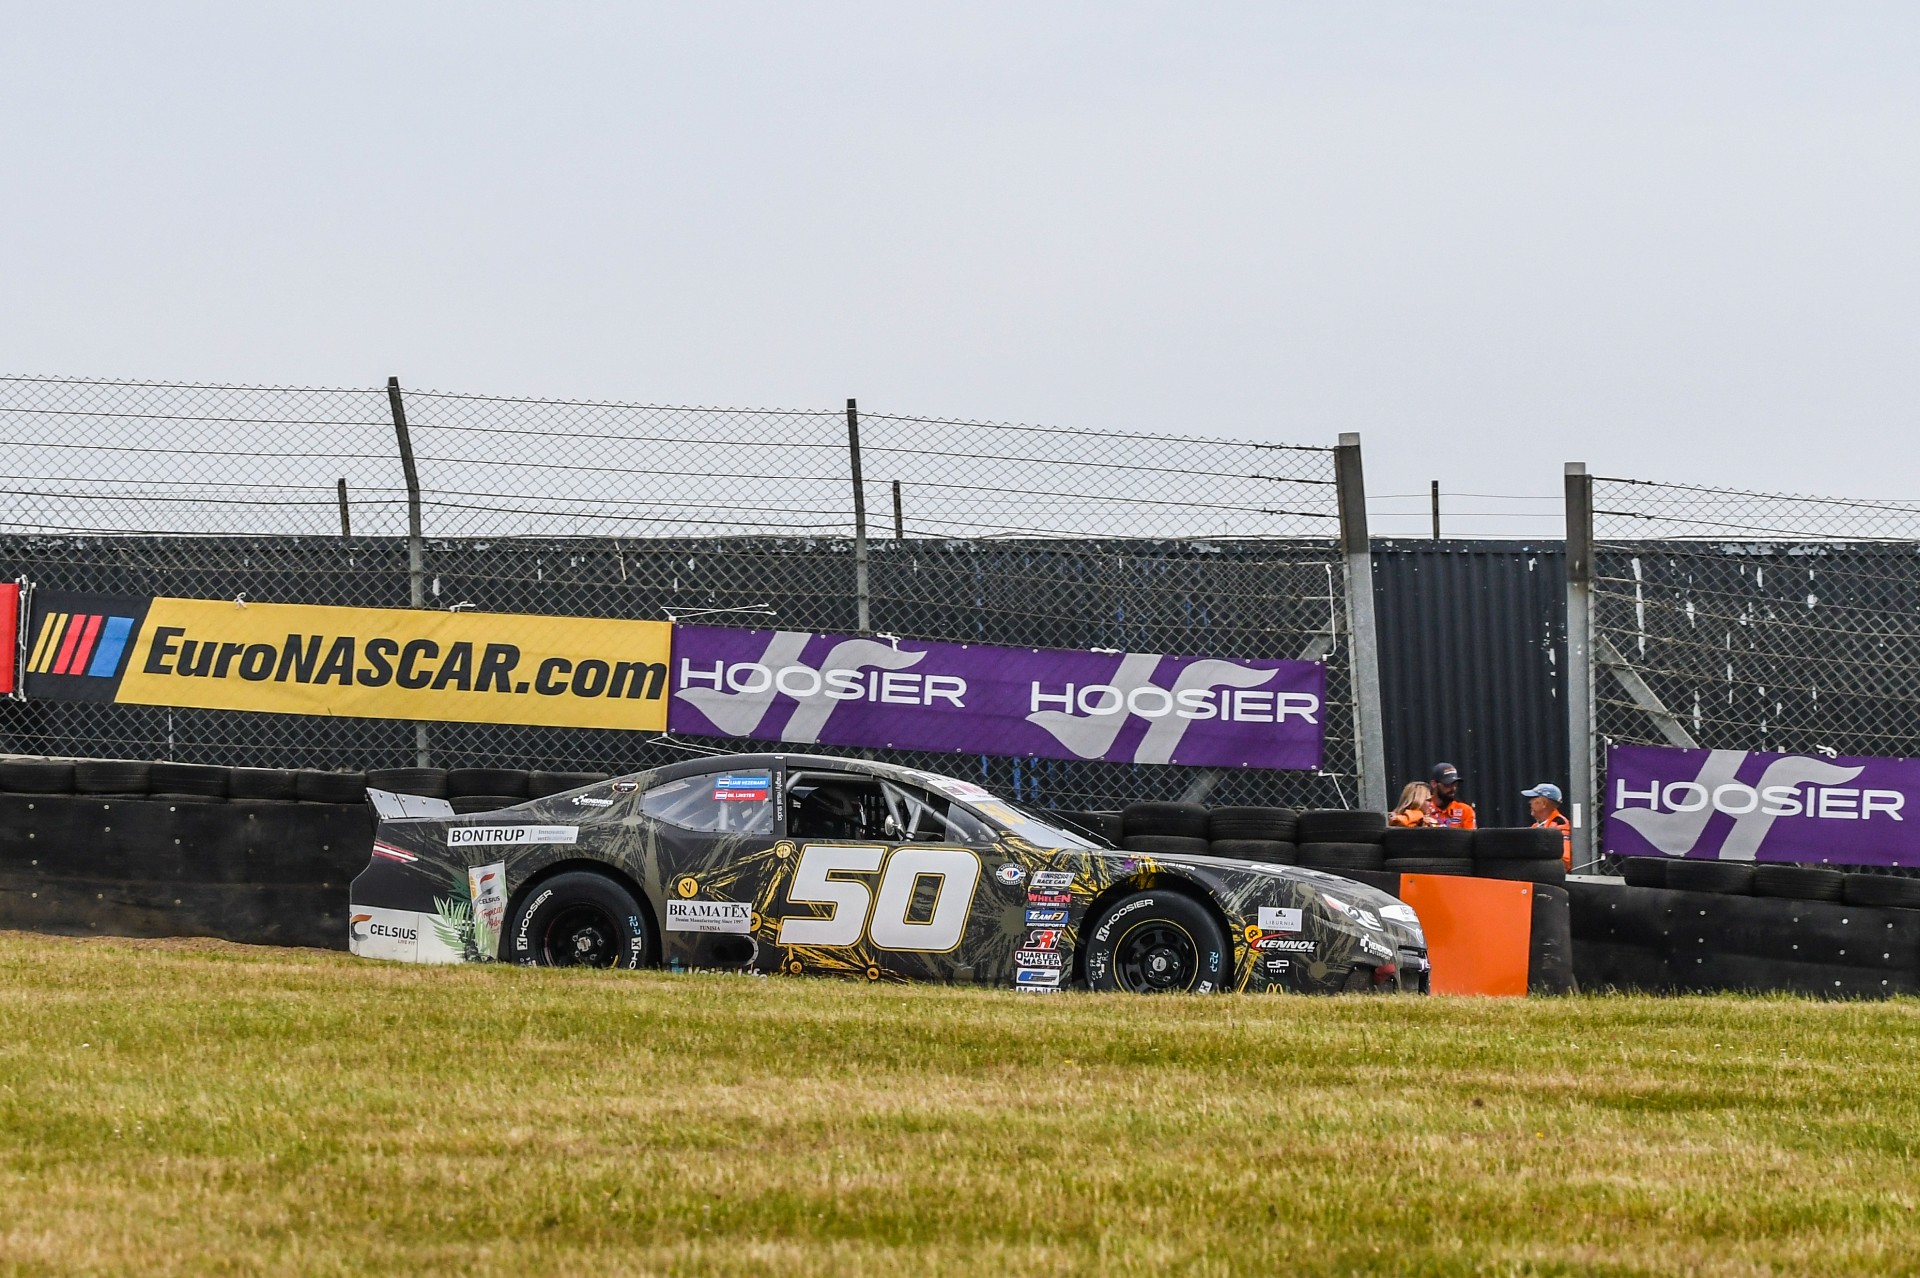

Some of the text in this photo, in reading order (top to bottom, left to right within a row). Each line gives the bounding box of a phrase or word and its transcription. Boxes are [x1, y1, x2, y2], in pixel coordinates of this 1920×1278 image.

[142, 625, 667, 700] EuroNASCAR.com
[678, 657, 967, 708] HOOSIER
[1030, 681, 1319, 724] HOOSIER
[1615, 778, 1905, 821] HOOSIER
[452, 829, 525, 842] BONTRUP
[1139, 861, 1196, 871] HOOSIER
[480, 895, 501, 905] CELSIUS
[776, 844, 982, 954] 50
[519, 889, 554, 937] HOOSIER
[669, 904, 749, 918] BRAMATEX
[1104, 899, 1154, 930] HOOSIER
[370, 923, 417, 940] CELSIUS
[1255, 940, 1317, 950] KENNOL
[1015, 951, 1058, 961] QUARTER
[1023, 958, 1060, 966] MASTER
